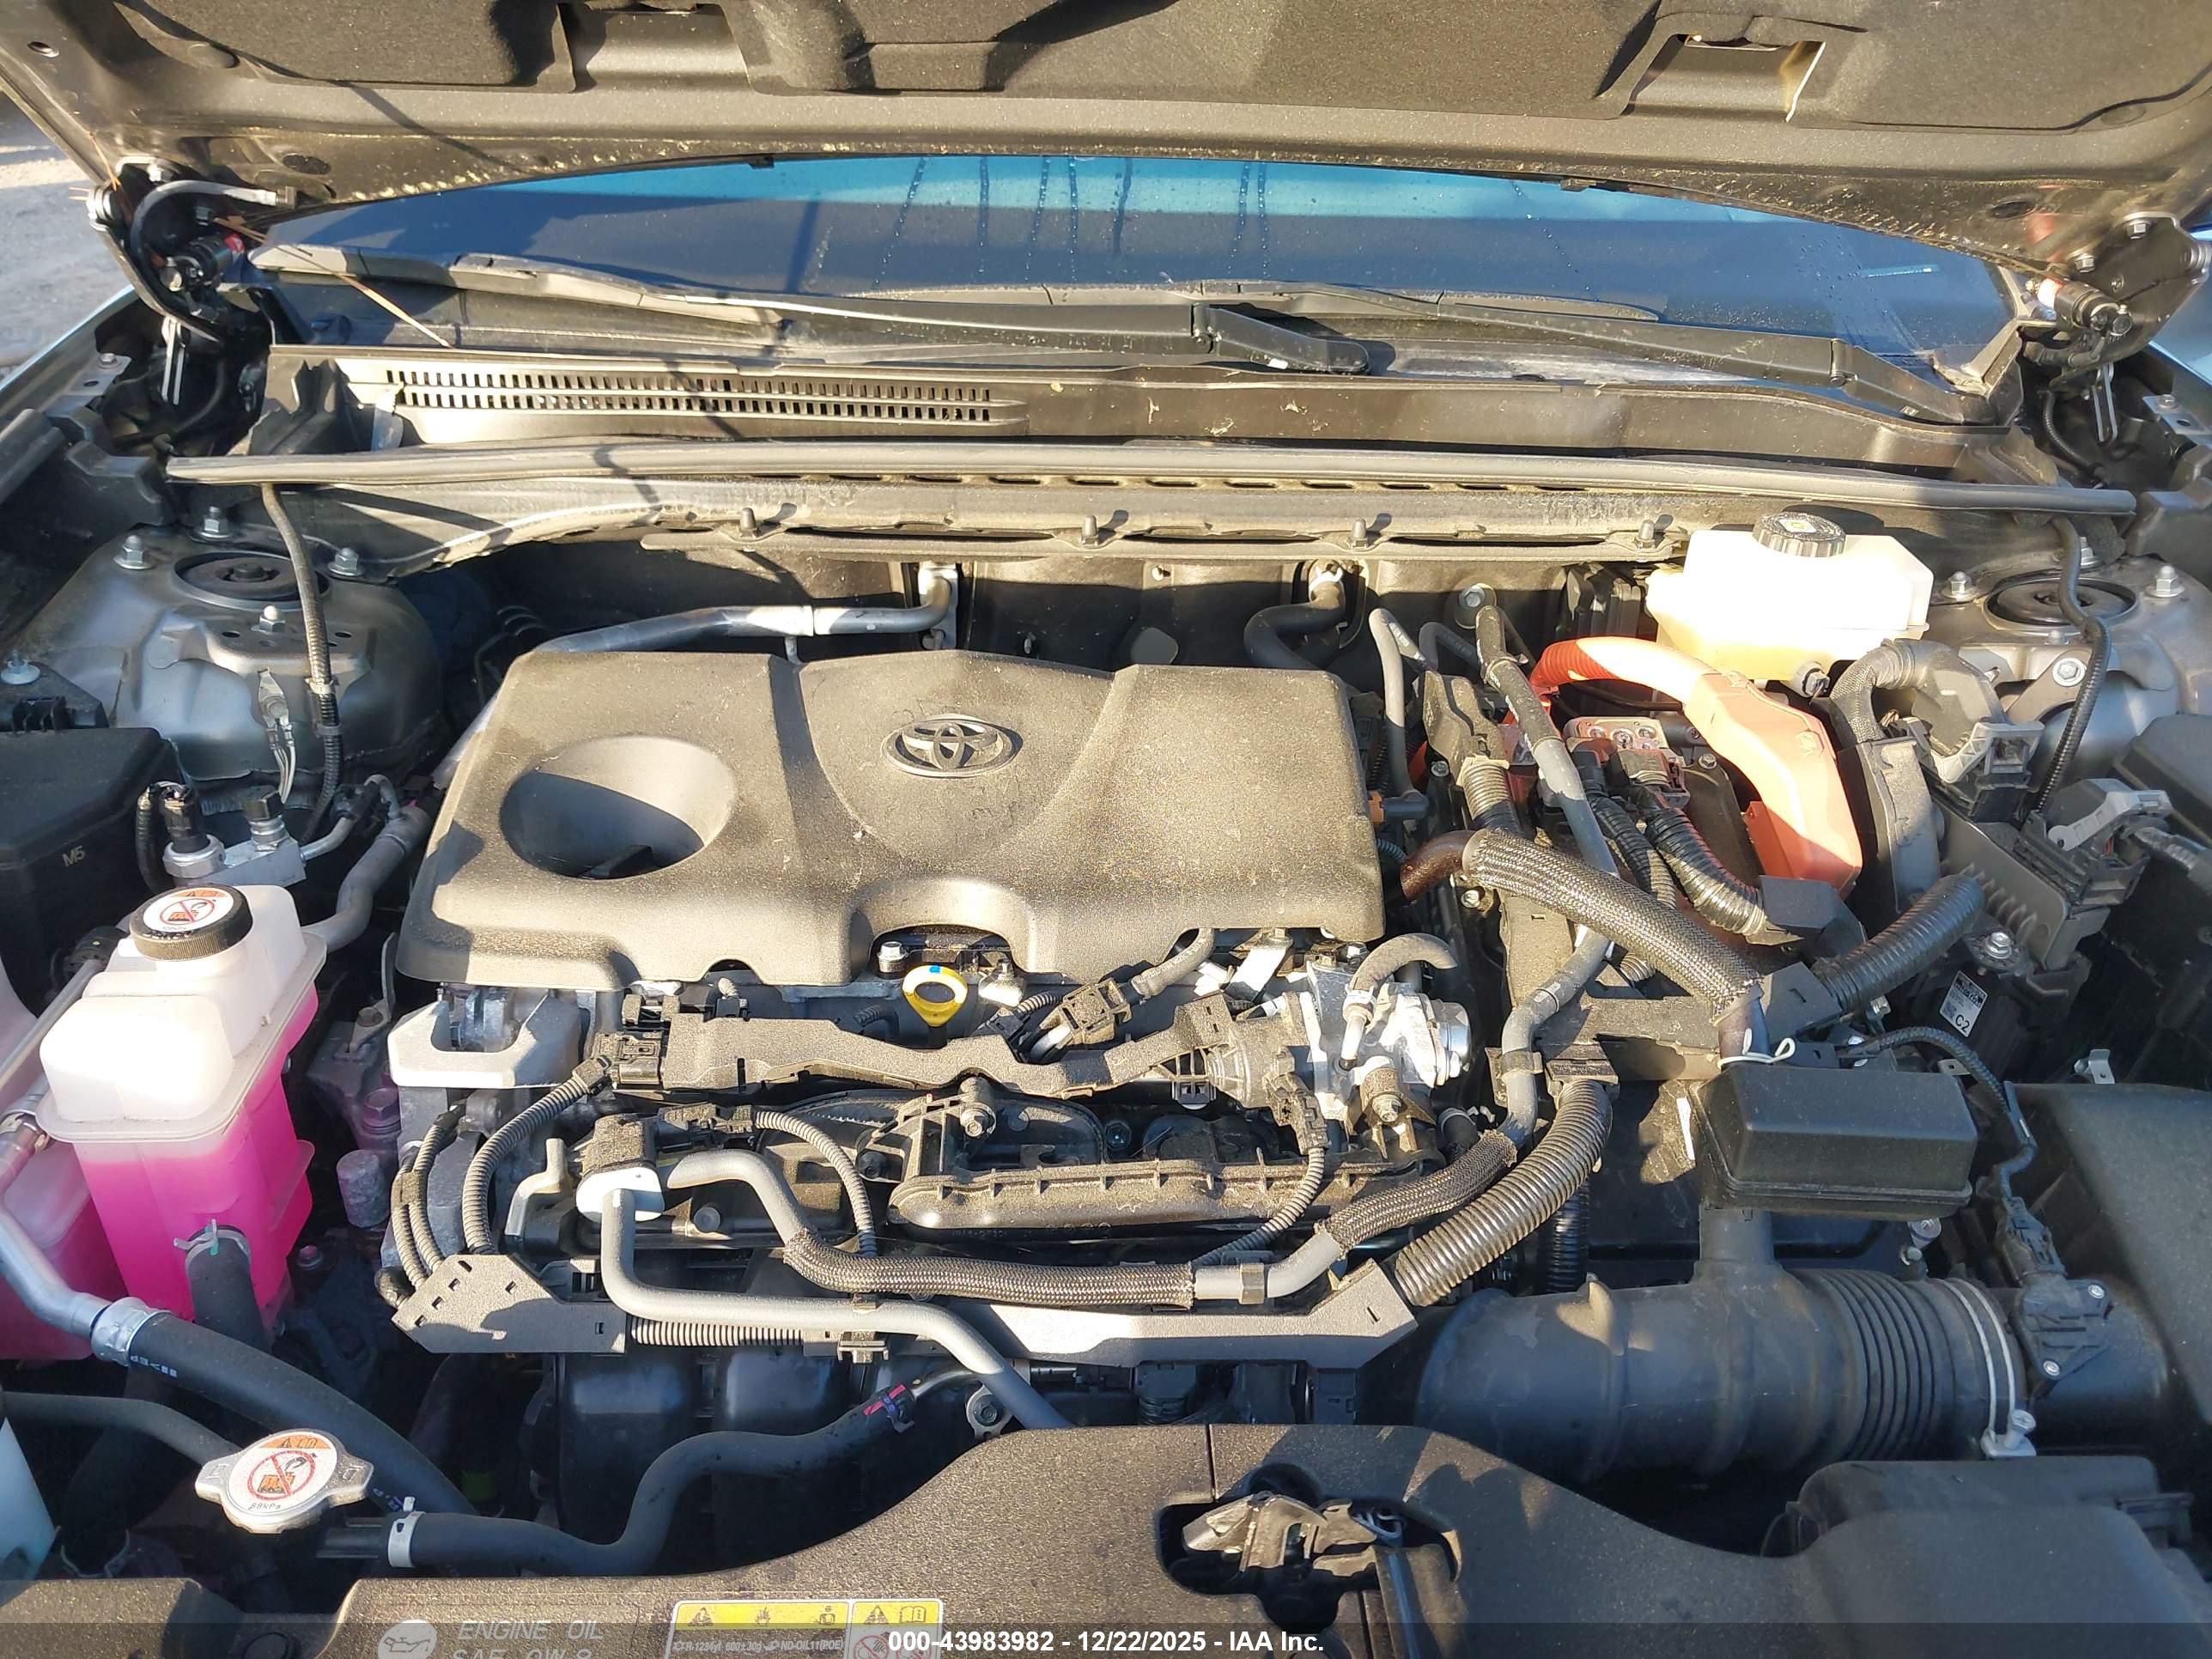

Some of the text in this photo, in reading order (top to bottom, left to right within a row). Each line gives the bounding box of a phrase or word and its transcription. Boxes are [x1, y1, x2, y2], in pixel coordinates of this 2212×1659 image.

[63, 845, 85, 867] M5
[1955, 1014, 1970, 1033] C2
[457, 1620, 604, 1640] ENGINE OIL
